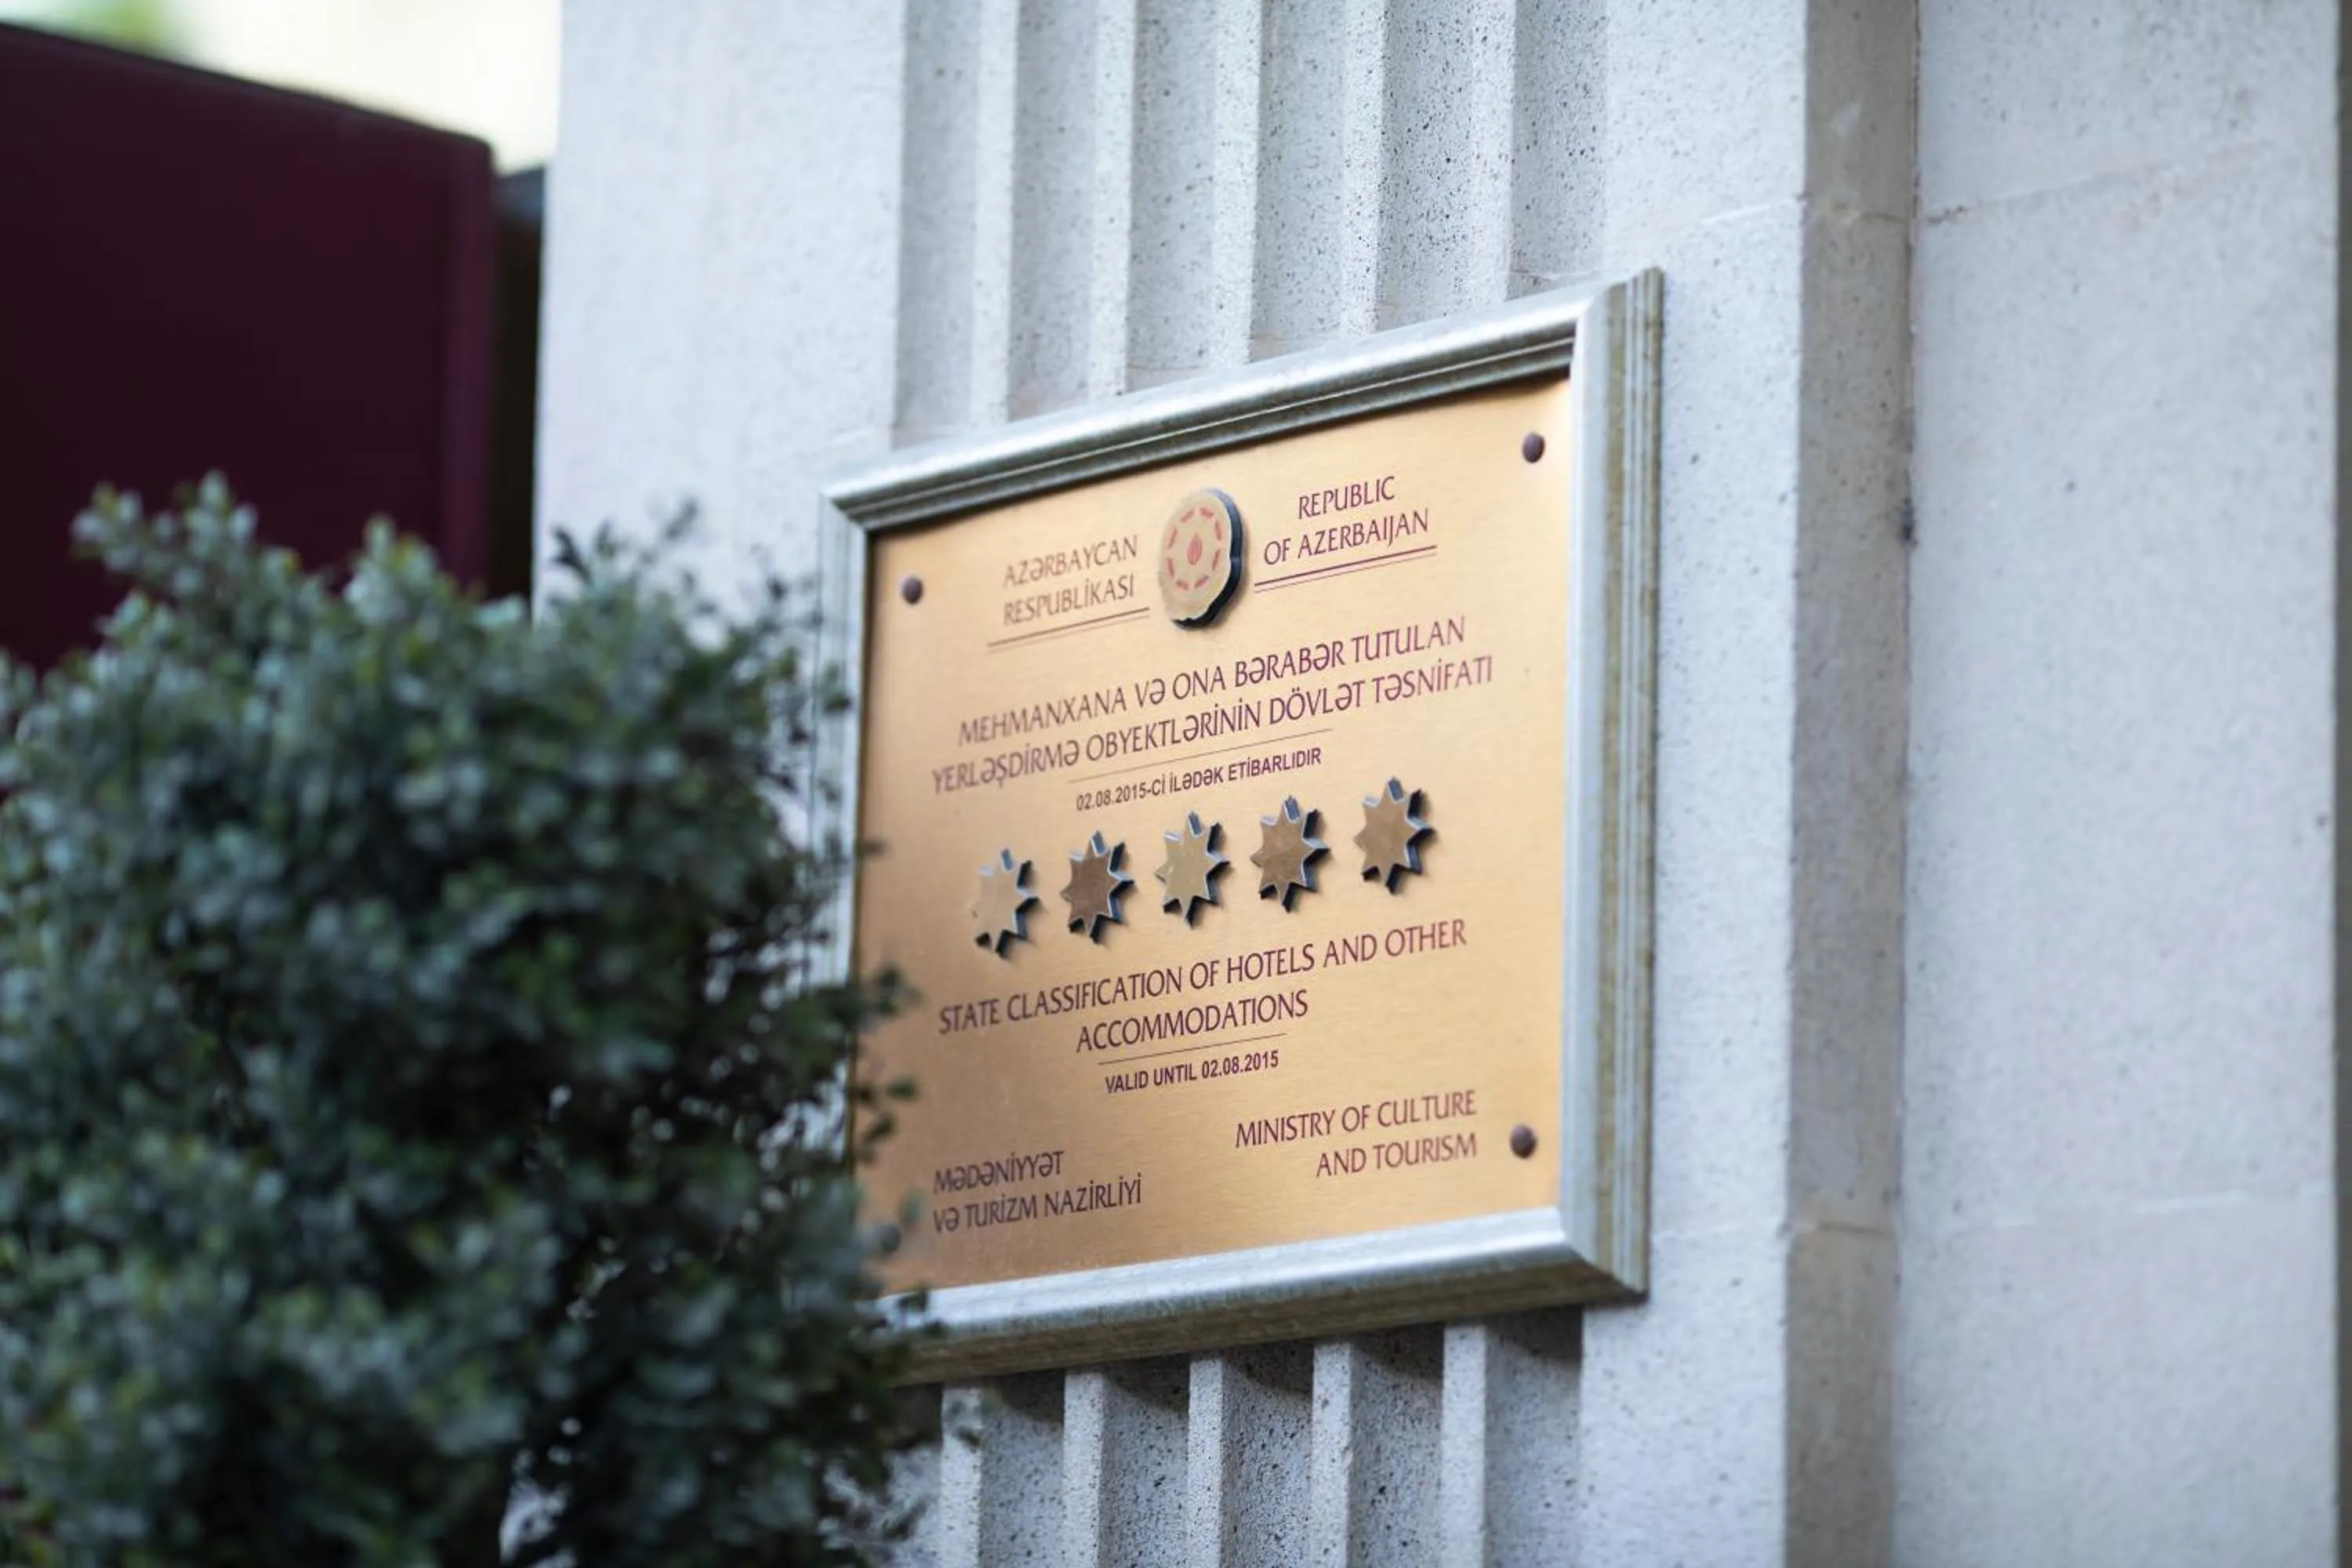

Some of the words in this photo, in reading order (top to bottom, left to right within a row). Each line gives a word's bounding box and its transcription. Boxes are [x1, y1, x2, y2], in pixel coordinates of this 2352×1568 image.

[1298, 476, 1395, 519] REPUBLIC
[1264, 538, 1291, 565] OF
[1298, 508, 1429, 559] AZERBAIJAN
[1004, 574, 1134, 625] RESPUBLİKASI
[958, 688, 1127, 746] MEHMANXANA
[1172, 666, 1226, 700] ONA
[1352, 615, 1465, 662] TUTULAN
[1229, 747, 1322, 782] ETİBARLIDIR
[939, 998, 1000, 1035] STATE
[1007, 966, 1182, 1022] CLASSIFICATION
[1189, 960, 1221, 989] OF
[1227, 943, 1315, 983] HOTELS
[1323, 934, 1377, 968] AND
[1385, 919, 1468, 958] OTHER
[1076, 989, 1308, 1053] ACCOMMODATIONS
[1105, 1073, 1149, 1094] VALID
[1153, 1063, 1198, 1086] UNTIL
[1201, 1050, 1279, 1080] 02.08.2015
[1236, 1109, 1335, 1148] MINISTRY
[1341, 1104, 1371, 1132] OF
[1377, 1089, 1477, 1127] CULTURE
[1316, 1148, 1366, 1178] AND
[1372, 1133, 1477, 1170] TOURISM
[964, 1192, 1038, 1229] TURİZM
[1044, 1172, 1142, 1217] NAZİRLİYİ
